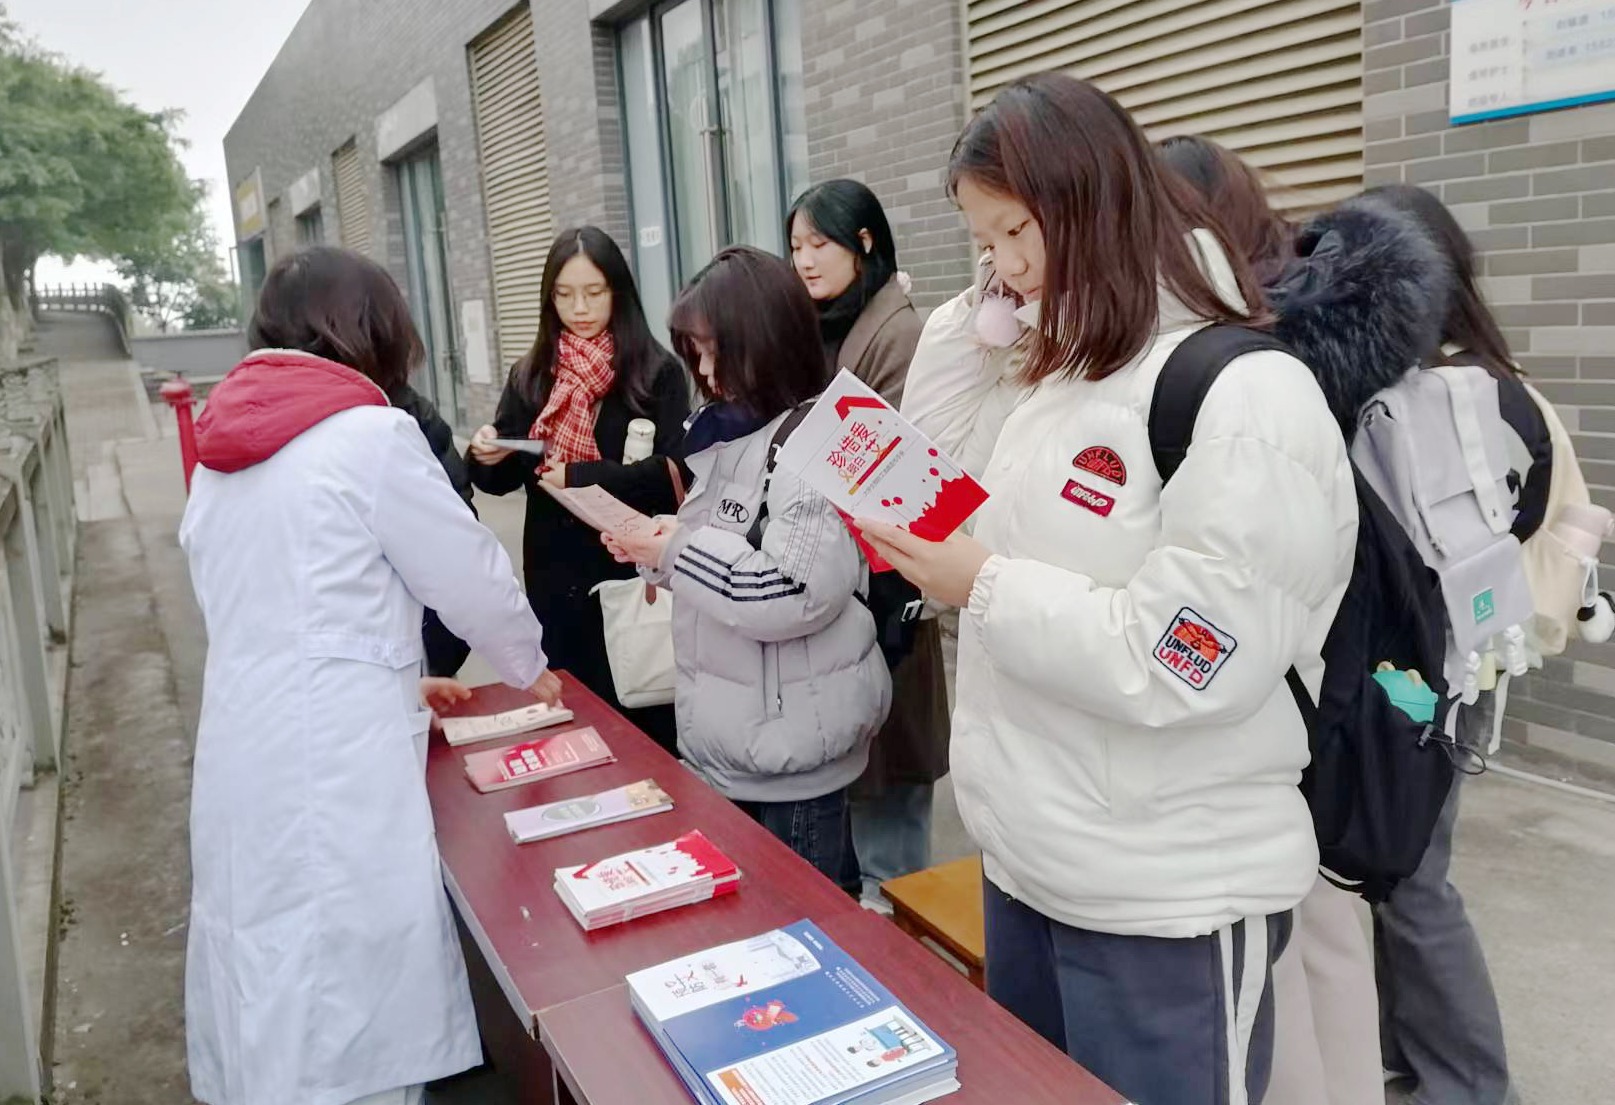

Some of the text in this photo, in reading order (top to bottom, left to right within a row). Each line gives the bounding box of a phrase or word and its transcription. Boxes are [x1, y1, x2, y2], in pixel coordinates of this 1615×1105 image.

[826, 421, 877, 468] 珍惜爱
[1078, 449, 1122, 478] UNFLUD
[1159, 646, 1204, 684] UNFD
[1165, 635, 1212, 674] UNFLUD
